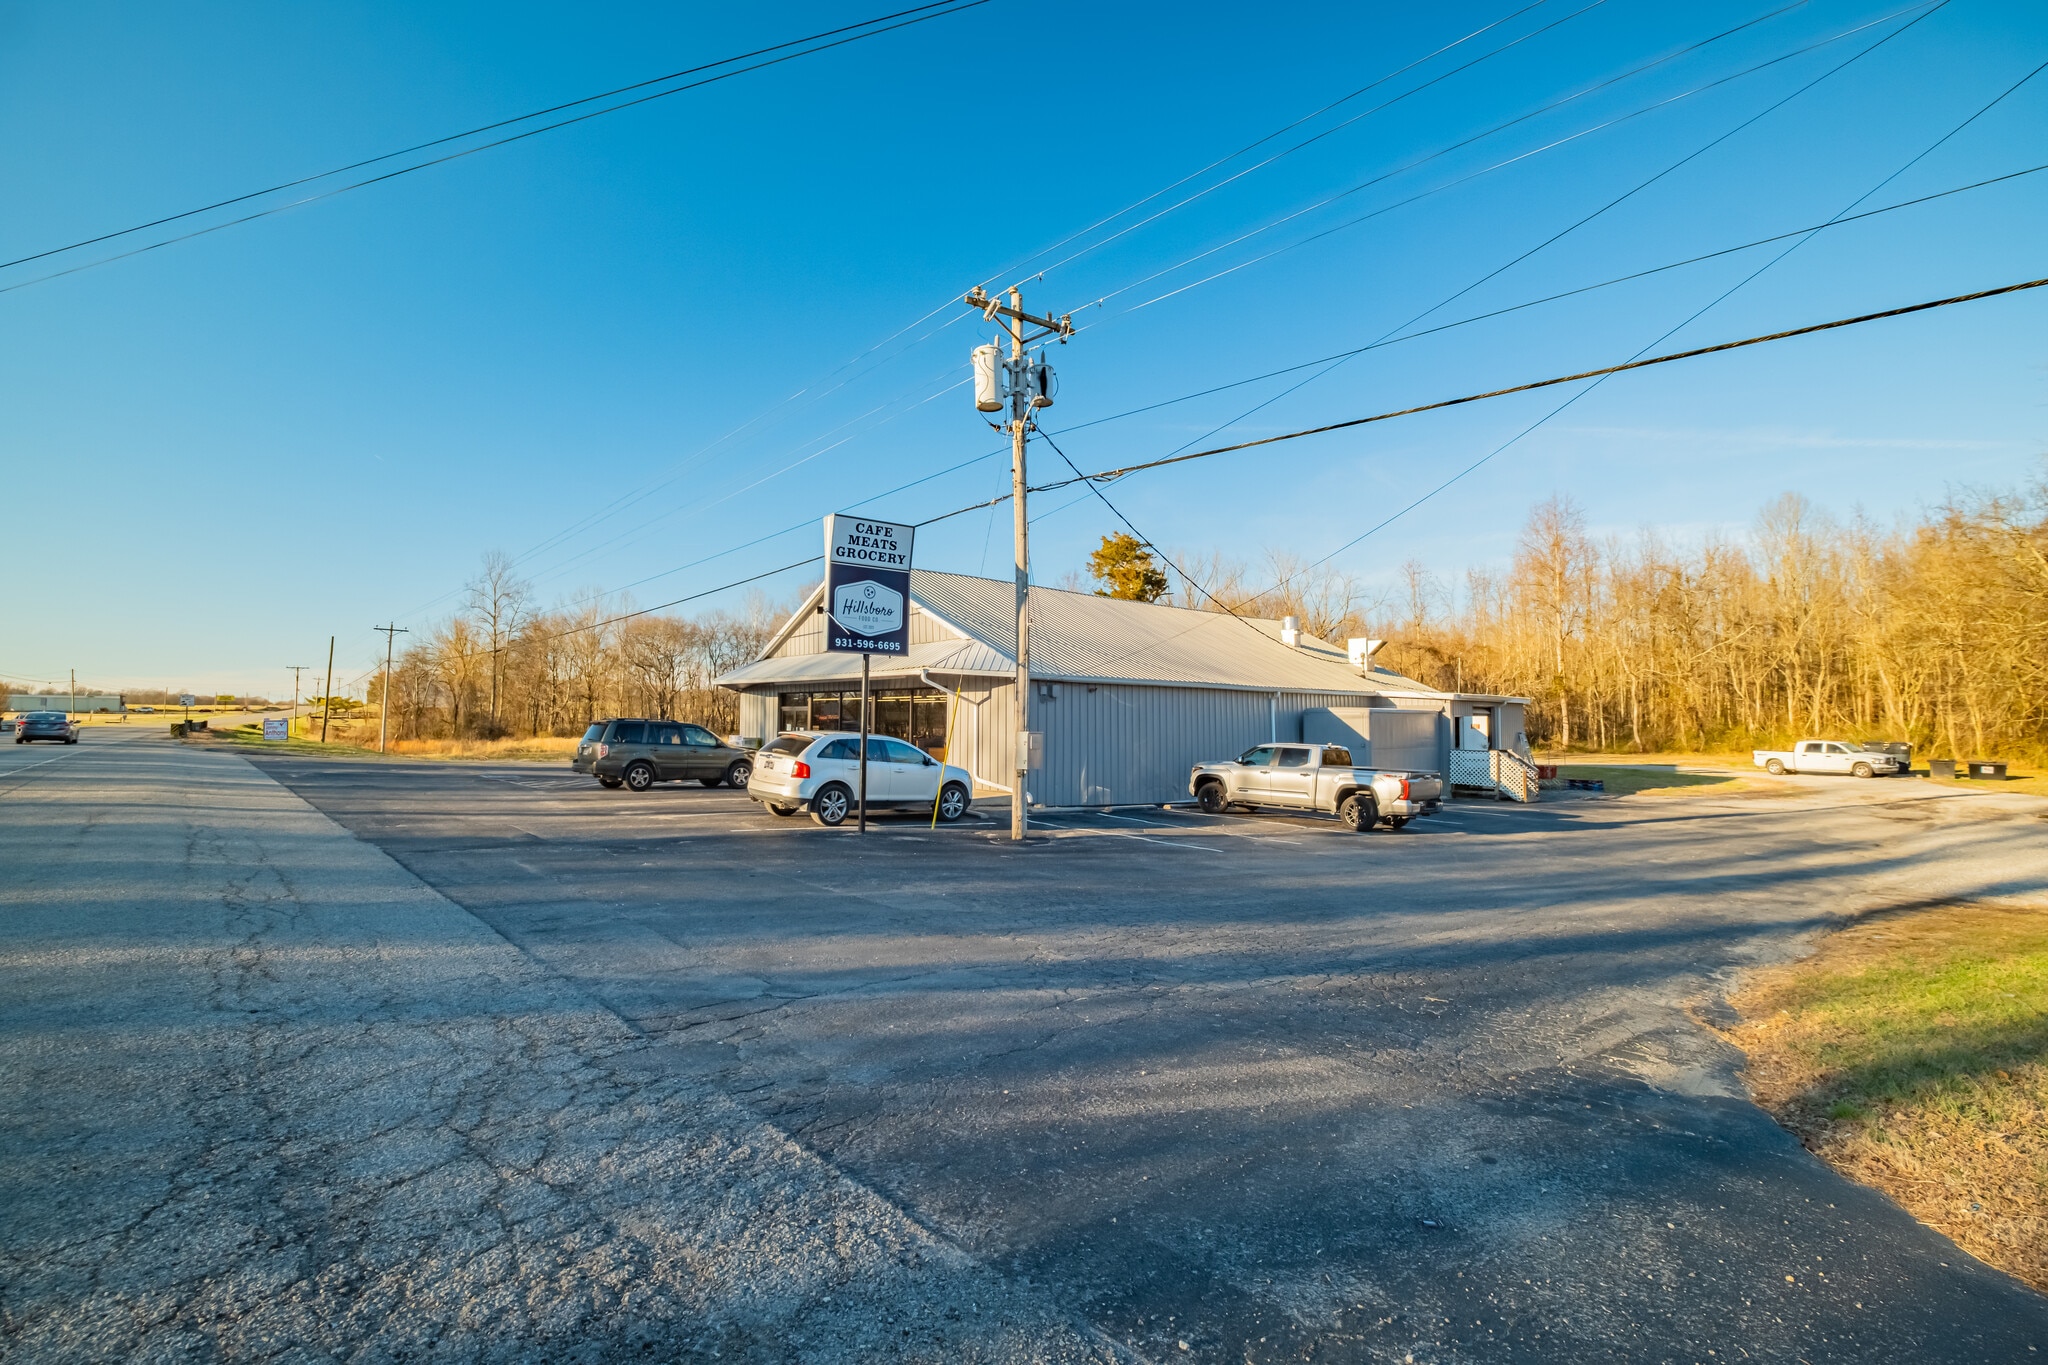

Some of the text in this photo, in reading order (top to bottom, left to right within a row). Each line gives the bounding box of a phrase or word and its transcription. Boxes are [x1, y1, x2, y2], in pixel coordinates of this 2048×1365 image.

[855, 522, 893, 538] CAFE
[848, 534, 897, 551] MEATS
[836, 546, 906, 565] GROCERY
[842, 598, 895, 616] Hillsboro
[835, 637, 901, 651] 931-596-6695
